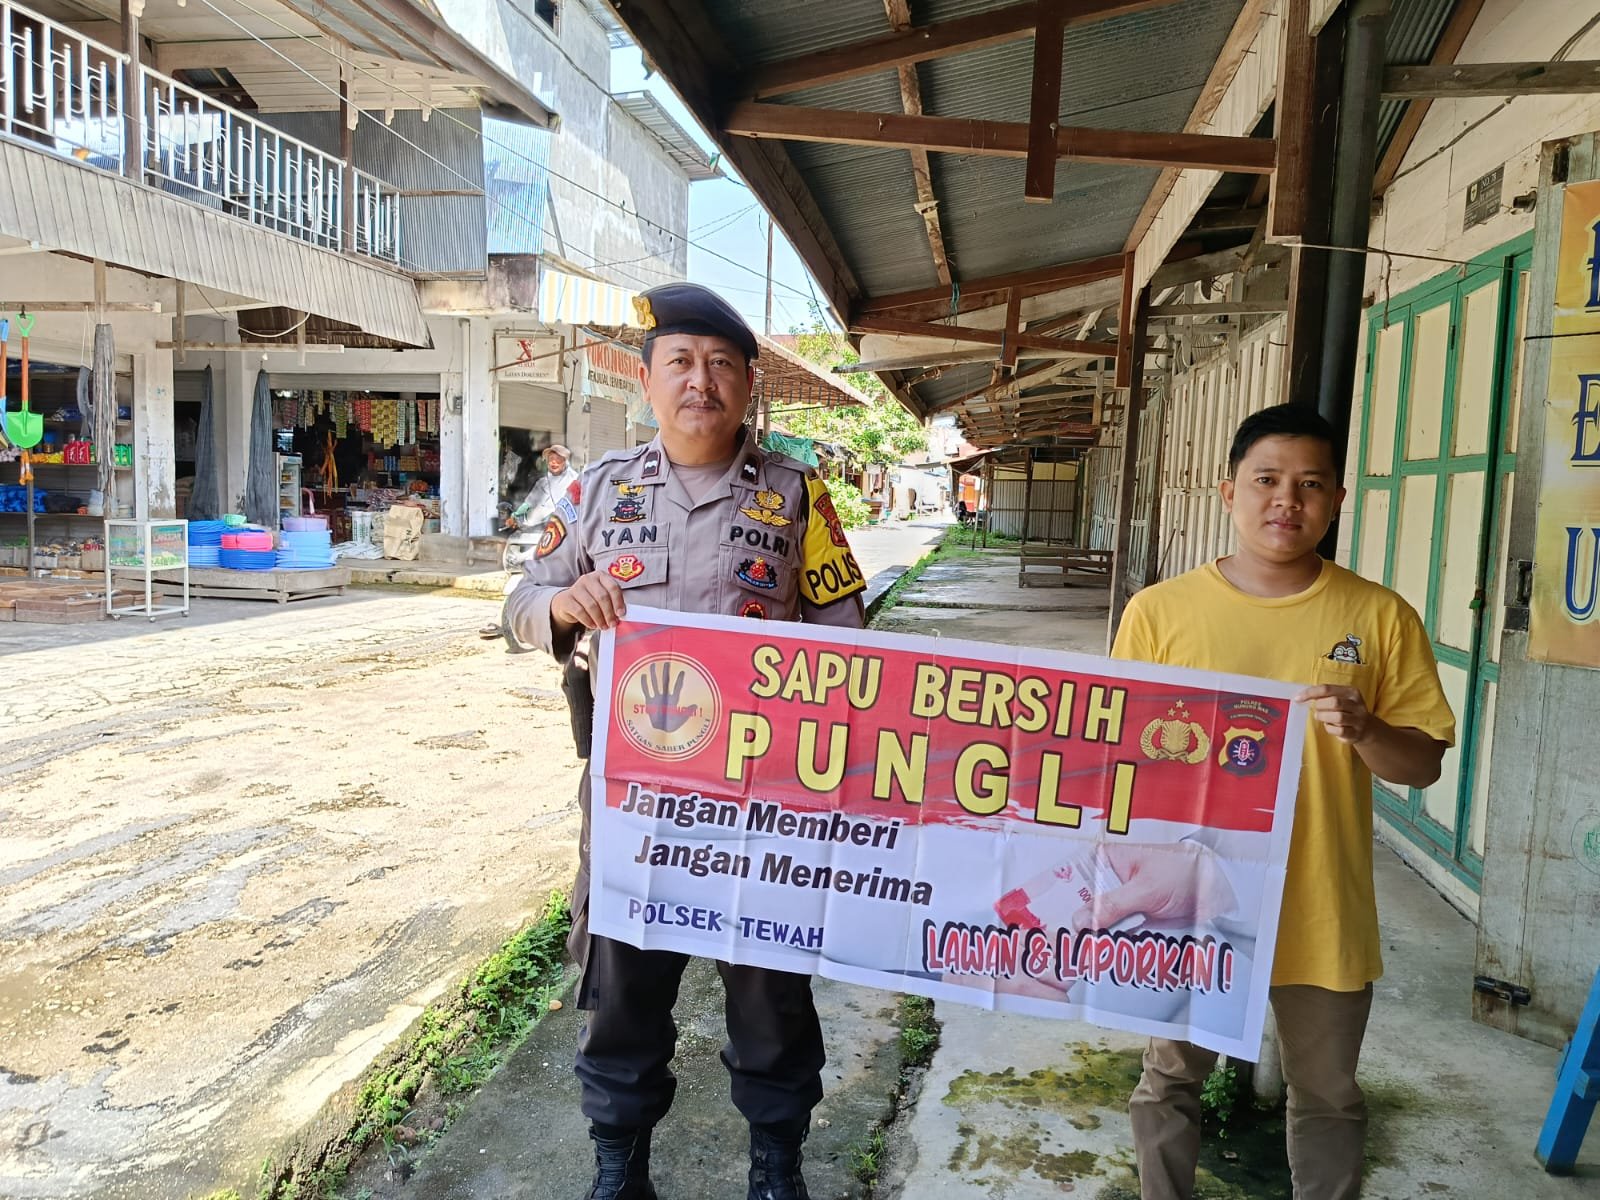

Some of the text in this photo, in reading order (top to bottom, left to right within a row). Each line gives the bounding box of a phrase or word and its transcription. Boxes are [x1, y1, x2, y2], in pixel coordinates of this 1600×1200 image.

[602, 525, 657, 547] YAN
[730, 525, 790, 557] POLRI
[805, 552, 861, 600] POLIS
[750, 644, 1128, 745] SAPU BERSIH
[724, 711, 1137, 835] PUNGLI
[622, 785, 900, 850] Jangan Memberi
[635, 836, 933, 905] Jangan Menerima
[628, 898, 824, 948] POLSEK TEWAH
[923, 920, 1020, 978] LAWAN
[1025, 927, 1053, 978] &
